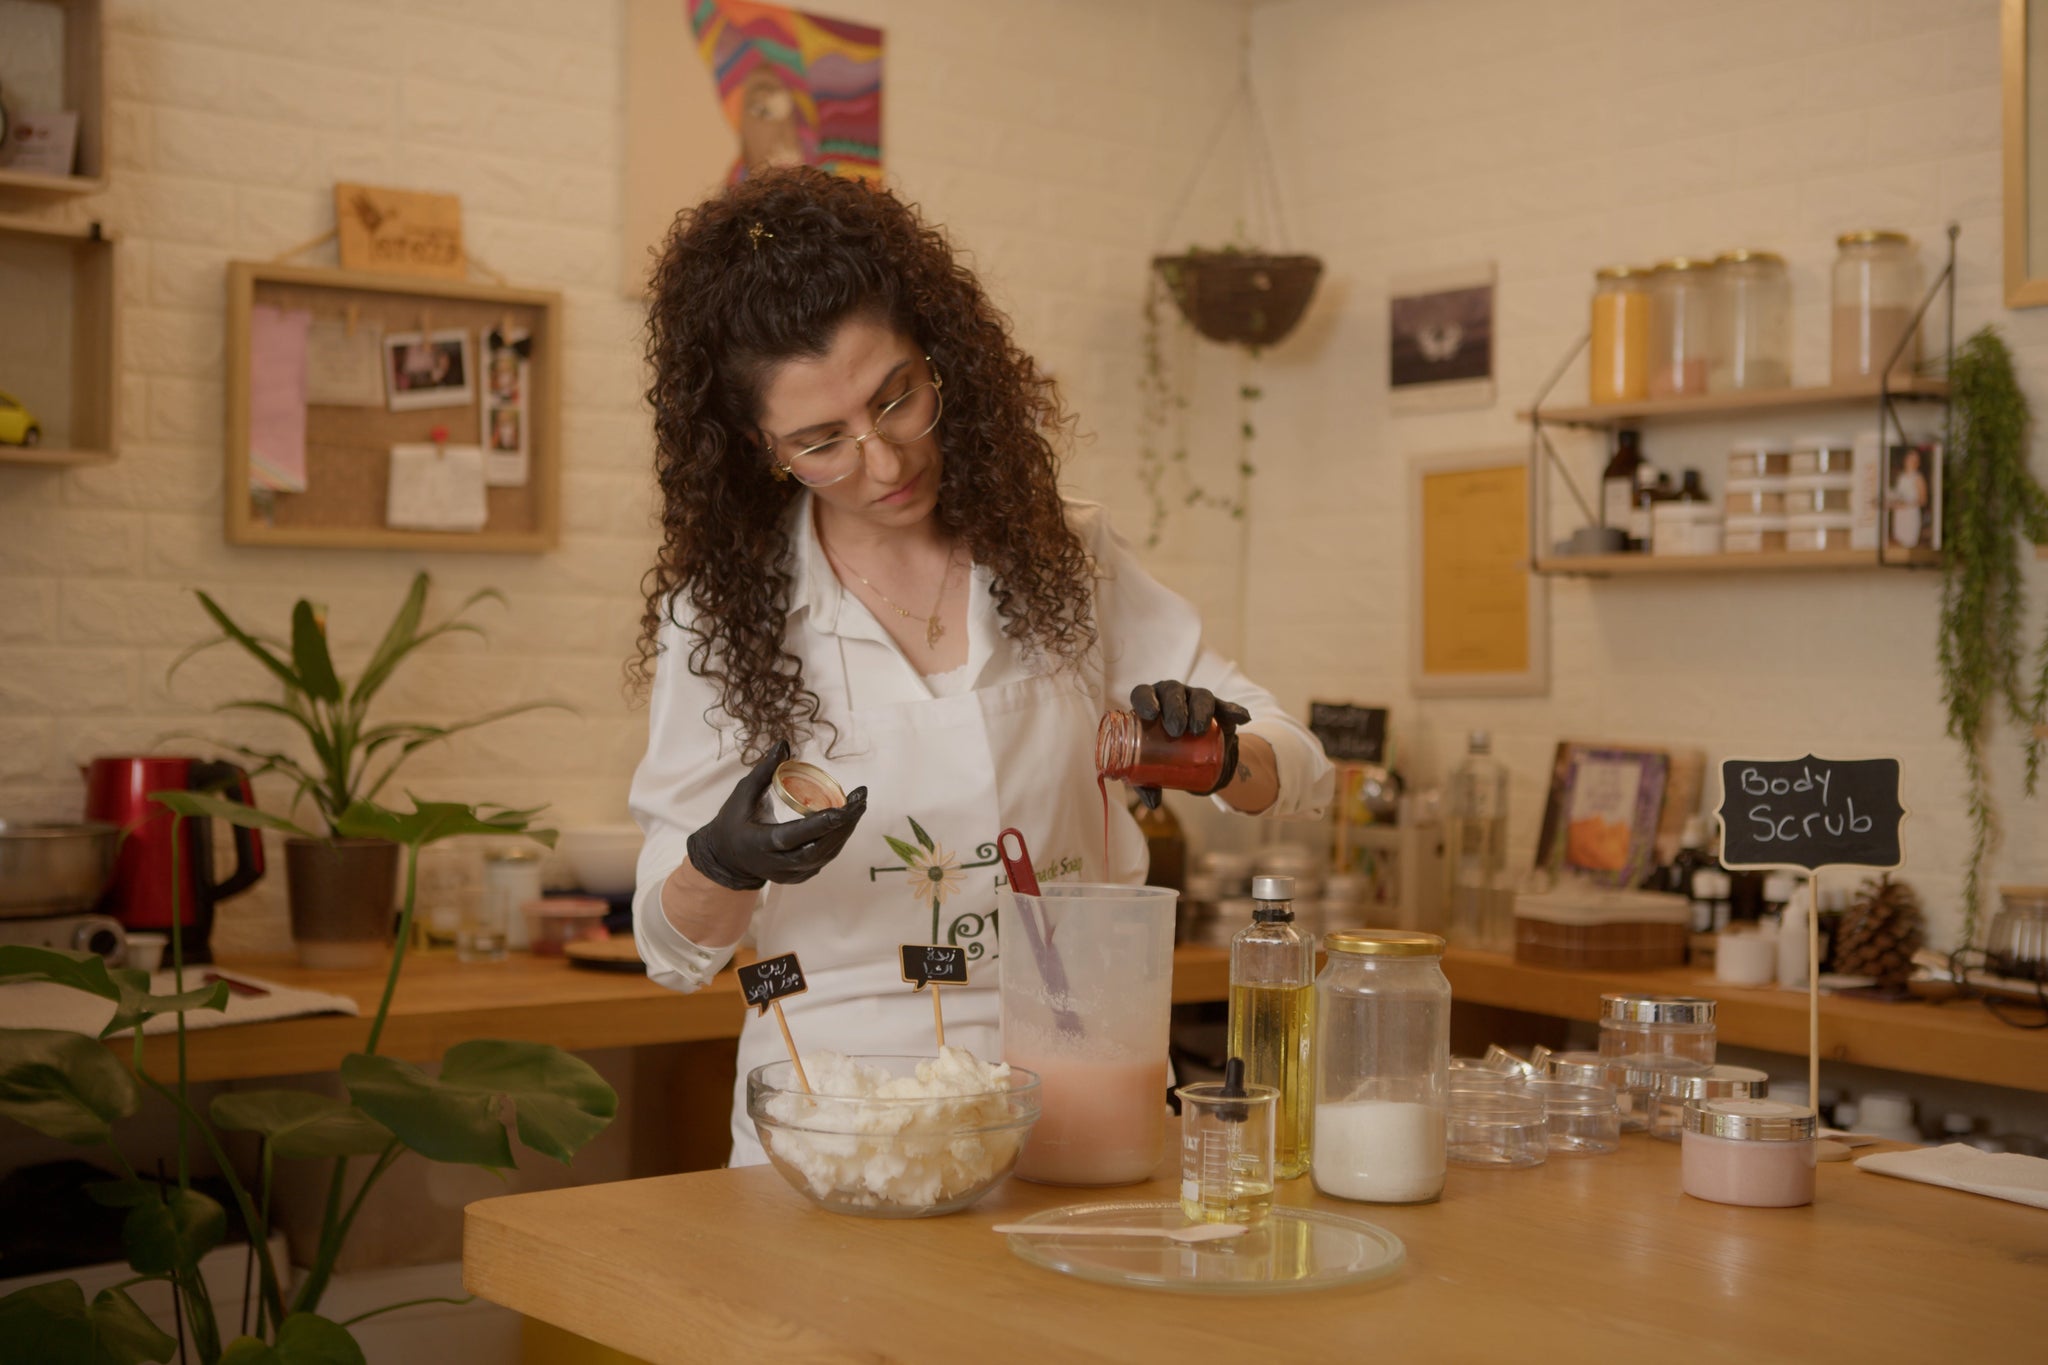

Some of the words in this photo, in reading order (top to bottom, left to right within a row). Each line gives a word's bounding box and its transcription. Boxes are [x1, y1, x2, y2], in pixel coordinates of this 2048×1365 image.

[1741, 766, 1831, 807] Body
[1748, 797, 1873, 842] Scrub
[926, 947, 956, 962] زبدة
[757, 958, 787, 979] زيت
[780, 973, 800, 990] جوز
[1226, 1159, 1242, 1169] 100
